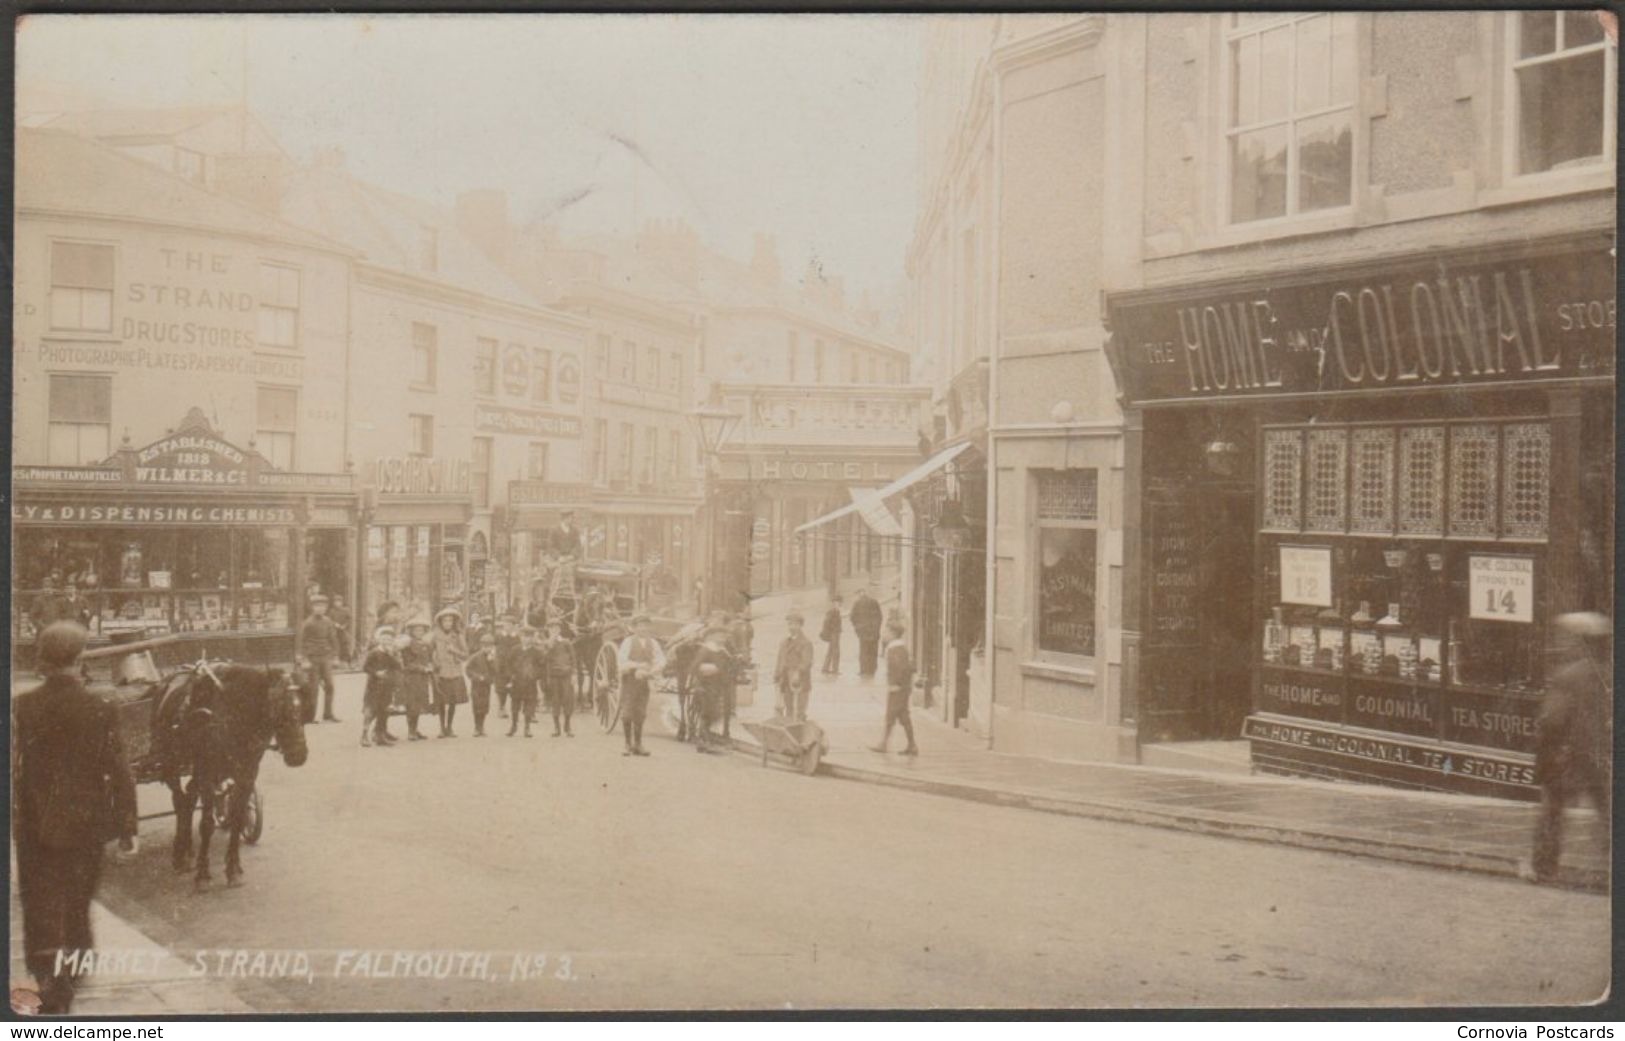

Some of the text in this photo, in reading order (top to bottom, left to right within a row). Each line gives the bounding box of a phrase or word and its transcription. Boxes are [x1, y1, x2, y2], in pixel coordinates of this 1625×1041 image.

[160, 248, 232, 274] THE
[127, 283, 254, 313] STRAND
[122, 317, 255, 350] DRUG STORES
[1144, 341, 1176, 364] THE
[1176, 299, 1283, 392] HOME
[1286, 328, 1322, 353] AND
[1330, 268, 1560, 383] COLONIAL
[38, 343, 136, 367] PHOTOGRAPHIC
[137, 347, 187, 371] PLATES
[138, 436, 244, 465] ESTABLISHED
[135, 467, 214, 482] WILMER
[762, 461, 891, 479] HOTEL
[41, 507, 54, 520] &
[60, 505, 204, 521] DISPENSING
[209, 507, 295, 521] CHEMISTS
[1264, 684, 1542, 738] THE HOME AND COLONIAL TEA STORES
[1271, 726, 1312, 746] HOME
[1336, 737, 1414, 764] COLONIAL
[1422, 751, 1453, 772] TEA
[1462, 759, 1535, 784] STORES
